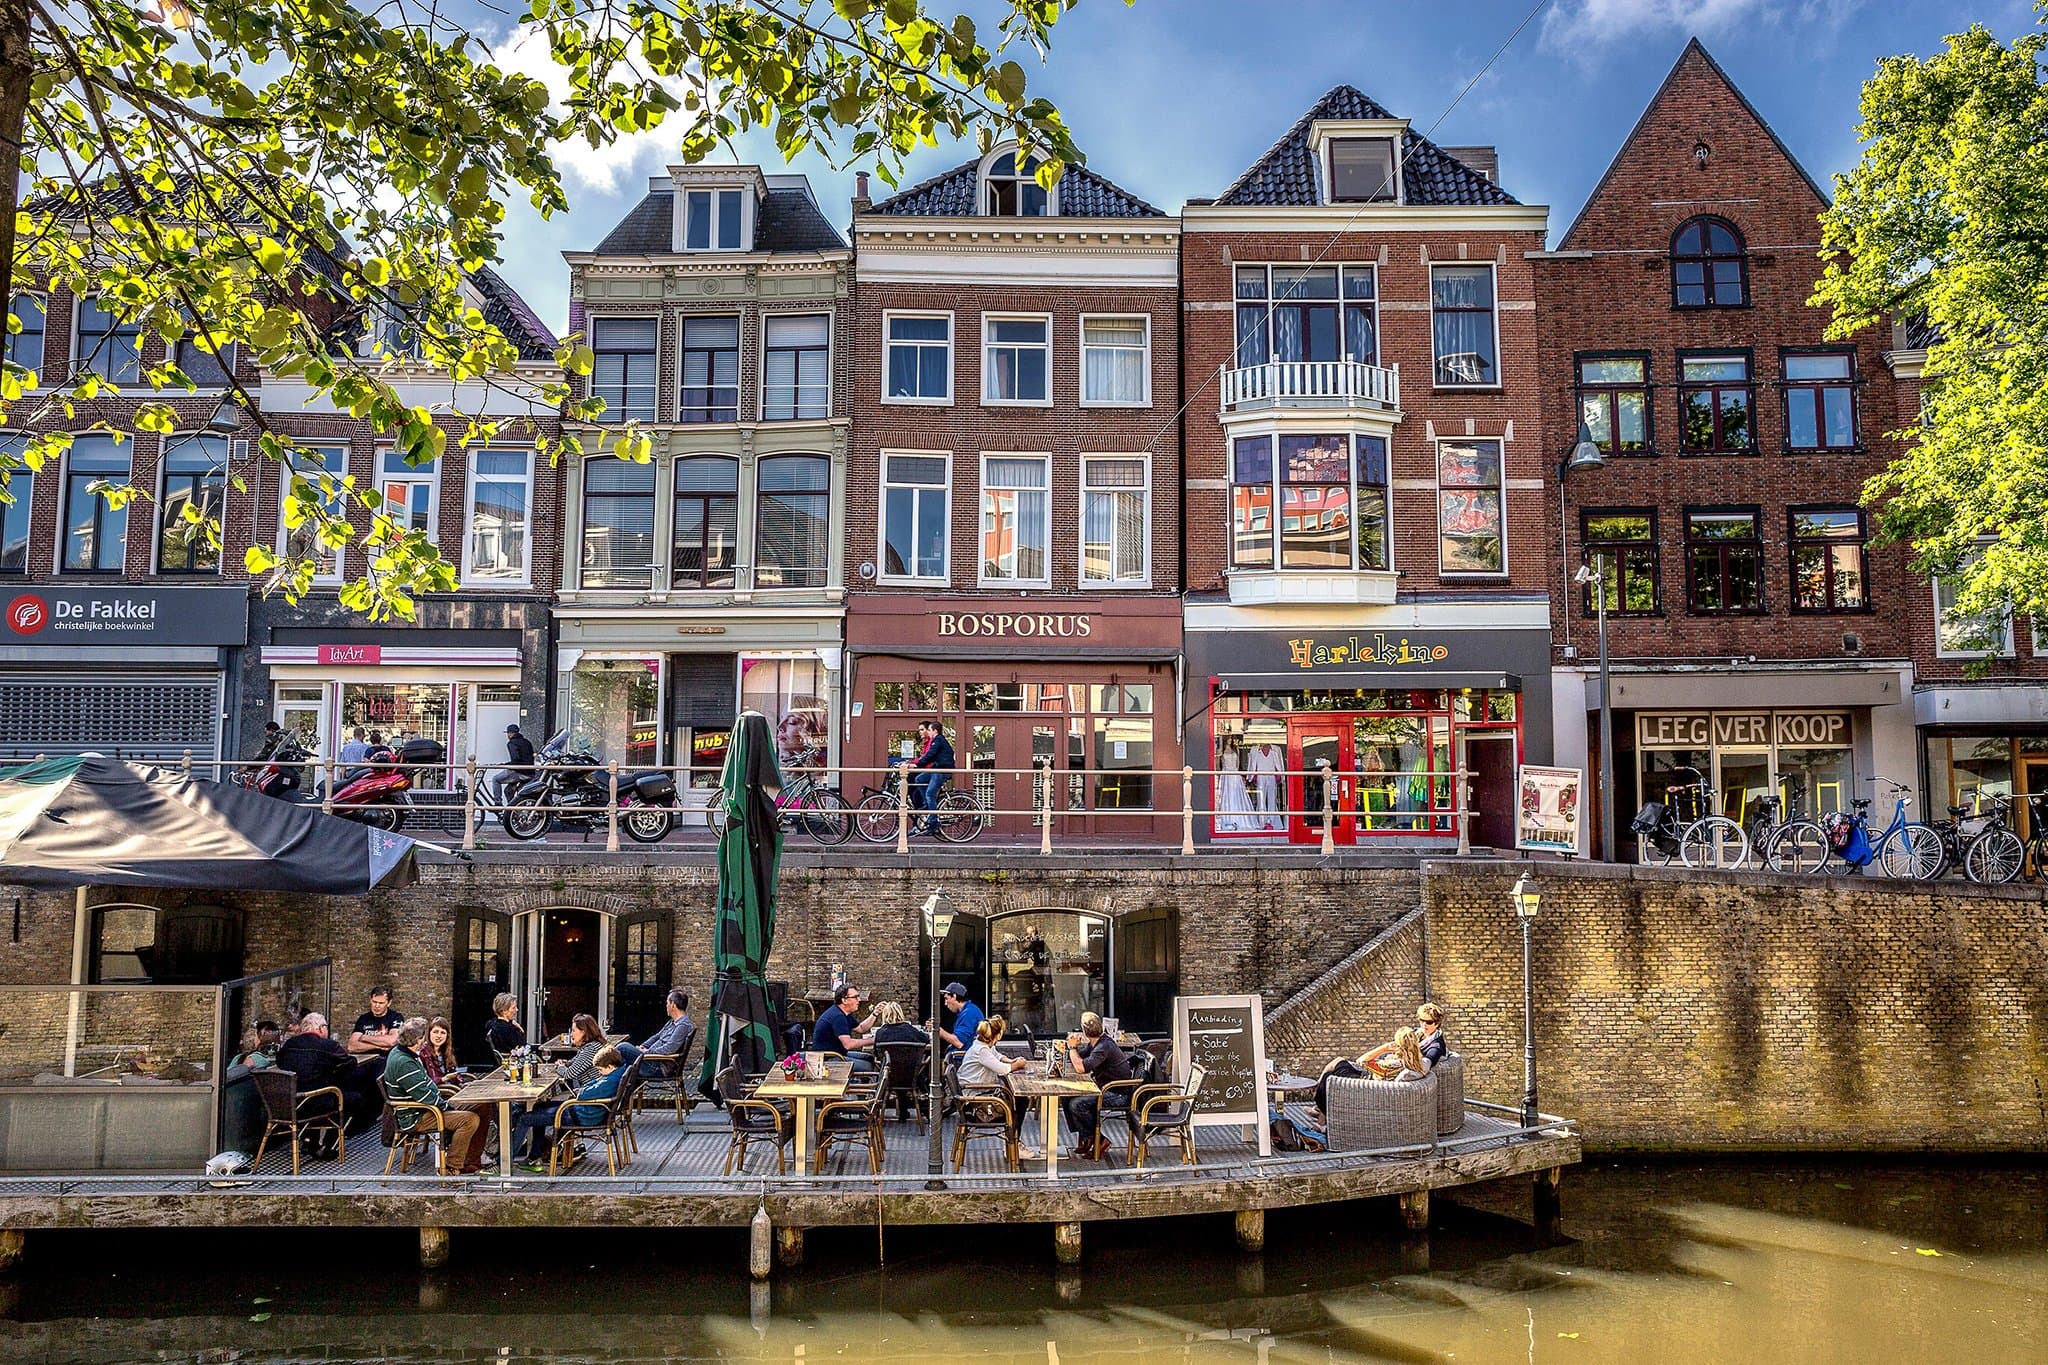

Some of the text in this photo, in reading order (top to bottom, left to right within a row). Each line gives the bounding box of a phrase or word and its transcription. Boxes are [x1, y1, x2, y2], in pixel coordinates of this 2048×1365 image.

[55, 600, 156, 619] De Fakkel
[54, 621, 155, 632] christelijke boekwinkel
[938, 614, 1091, 637] BOSPORUS
[329, 646, 365, 662] IdyArt
[1288, 633, 1449, 668] Harlekino
[1641, 715, 1845, 744] LEEG VER KOOP
[1202, 1035, 1230, 1049] Saté
